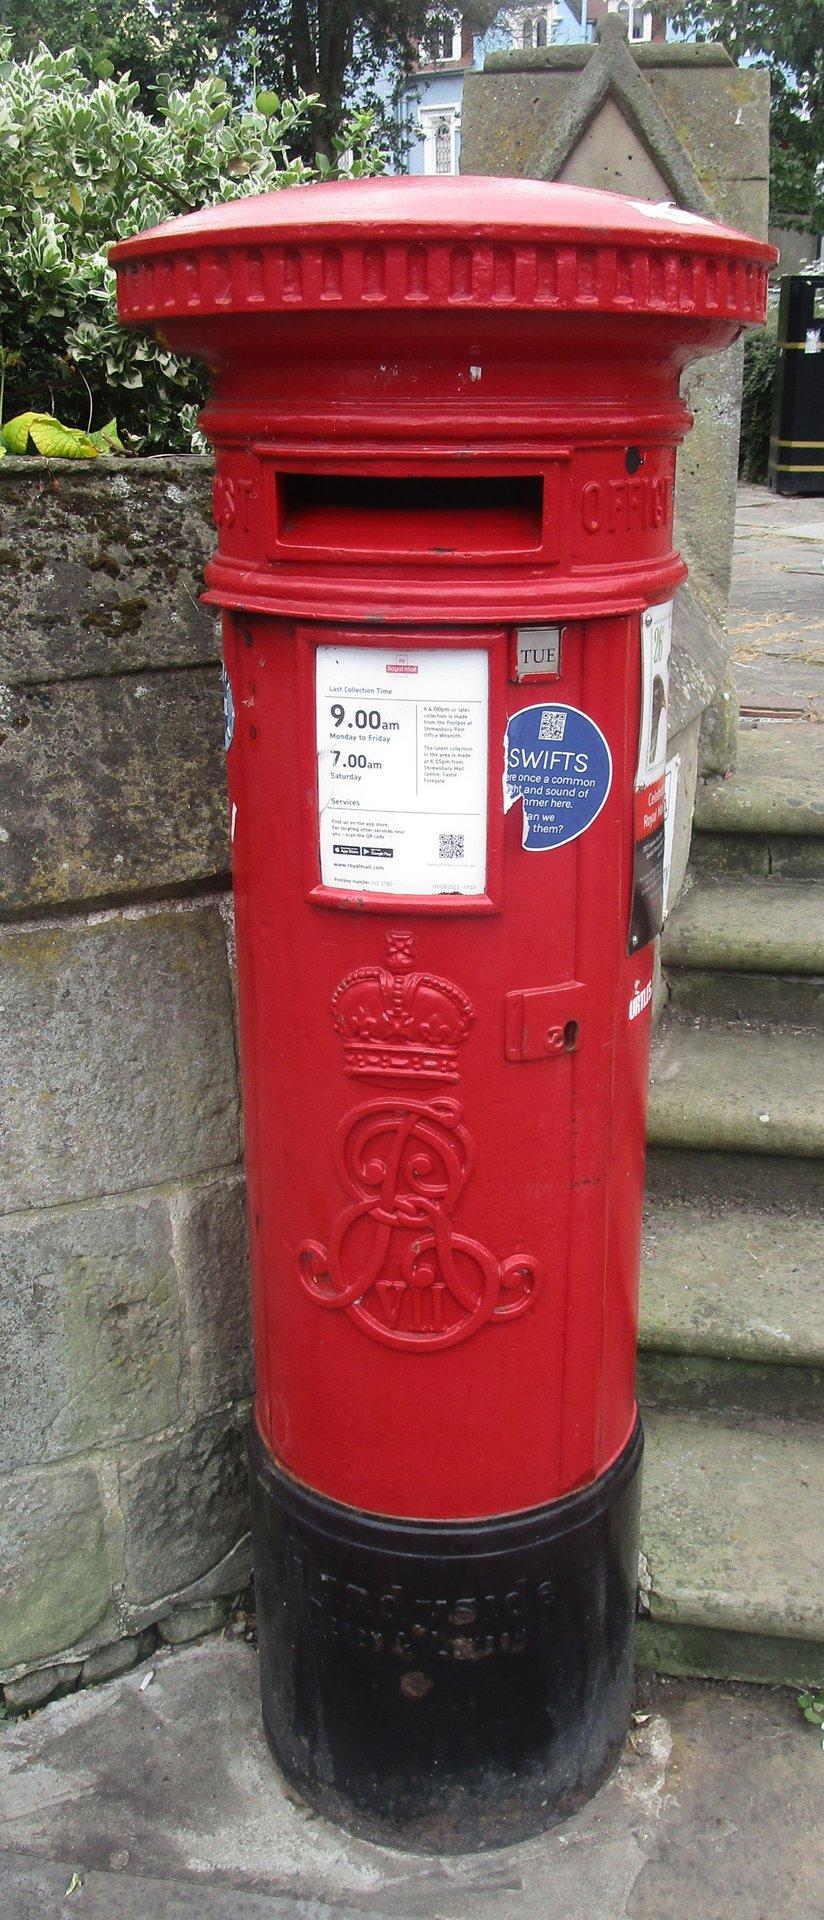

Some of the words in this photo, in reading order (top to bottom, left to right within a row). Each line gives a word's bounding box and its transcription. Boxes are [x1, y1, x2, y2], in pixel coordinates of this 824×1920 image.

[520, 648, 556, 664] TUE
[330, 703, 400, 730] 9.00am
[329, 733, 357, 742] Monday
[368, 734, 391, 743] Friday
[330, 750, 382, 769] 7.00am
[509, 748, 589, 773] SWIFTS
[330, 772, 362, 781] Saturday
[518, 774, 542, 783] once
[543, 776, 549, 784] a
[551, 776, 596, 787] common
[523, 785, 544, 795] and
[545, 786, 576, 797] sound
[578, 789, 590, 798] of
[330, 798, 360, 806] Services
[550, 798, 574, 809] here.
[527, 813, 540, 821] an
[541, 814, 555, 822] we
[532, 824, 565, 834] them?
